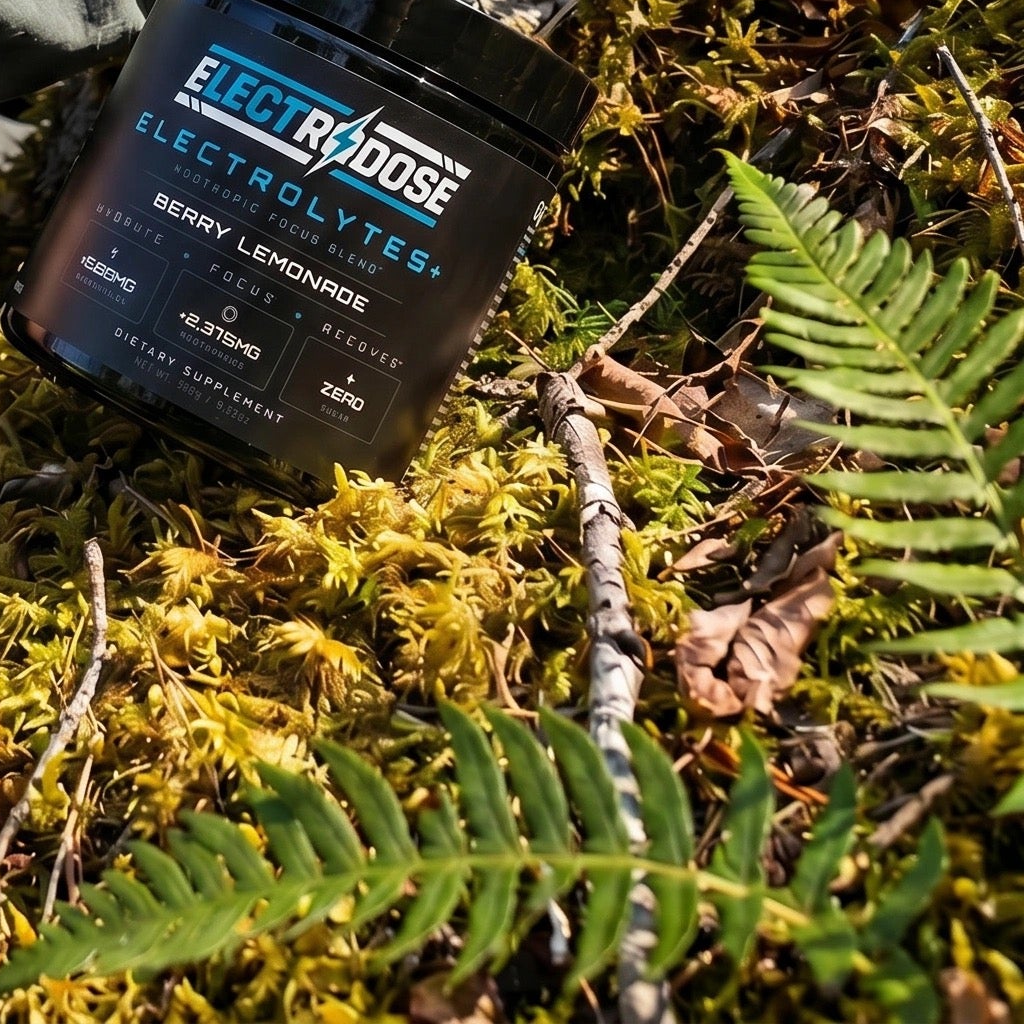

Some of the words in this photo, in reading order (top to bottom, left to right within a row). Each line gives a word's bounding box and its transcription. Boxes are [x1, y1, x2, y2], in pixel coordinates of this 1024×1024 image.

[184, 56, 460, 215] ELECTRODOSE
[135, 111, 441, 279] ELECTROLYTES+
[153, 192, 232, 240] BERRY
[237, 236, 370, 313] LEMONADE
[209, 263, 275, 304] FOCUS
[114, 327, 176, 366] DIETARY
[182, 365, 285, 424] SUPPLEMENT
[320, 381, 365, 412] ZERO
